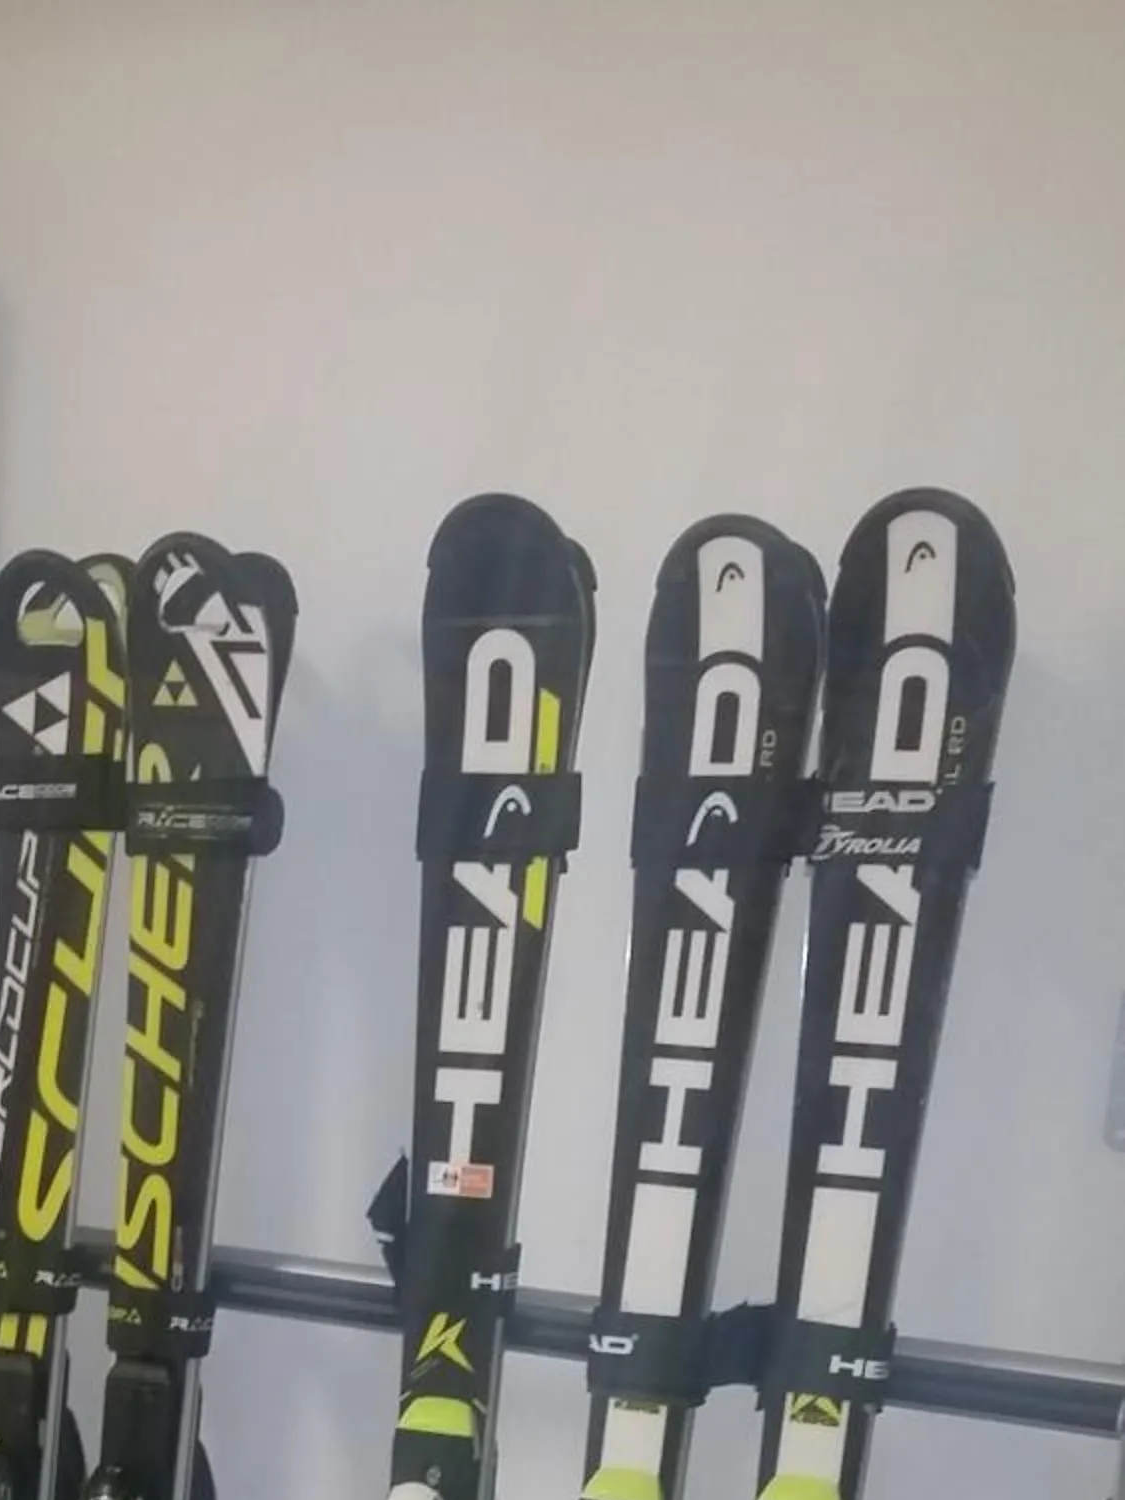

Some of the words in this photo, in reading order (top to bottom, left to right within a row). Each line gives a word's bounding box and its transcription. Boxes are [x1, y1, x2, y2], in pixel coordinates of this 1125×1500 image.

[759, 729, 777, 767] RD
[823, 789, 936, 813] EAD
[811, 824, 923, 860] TYROLIA
[115, 743, 196, 1290] ISCHE
[828, 1353, 890, 1381] HE
